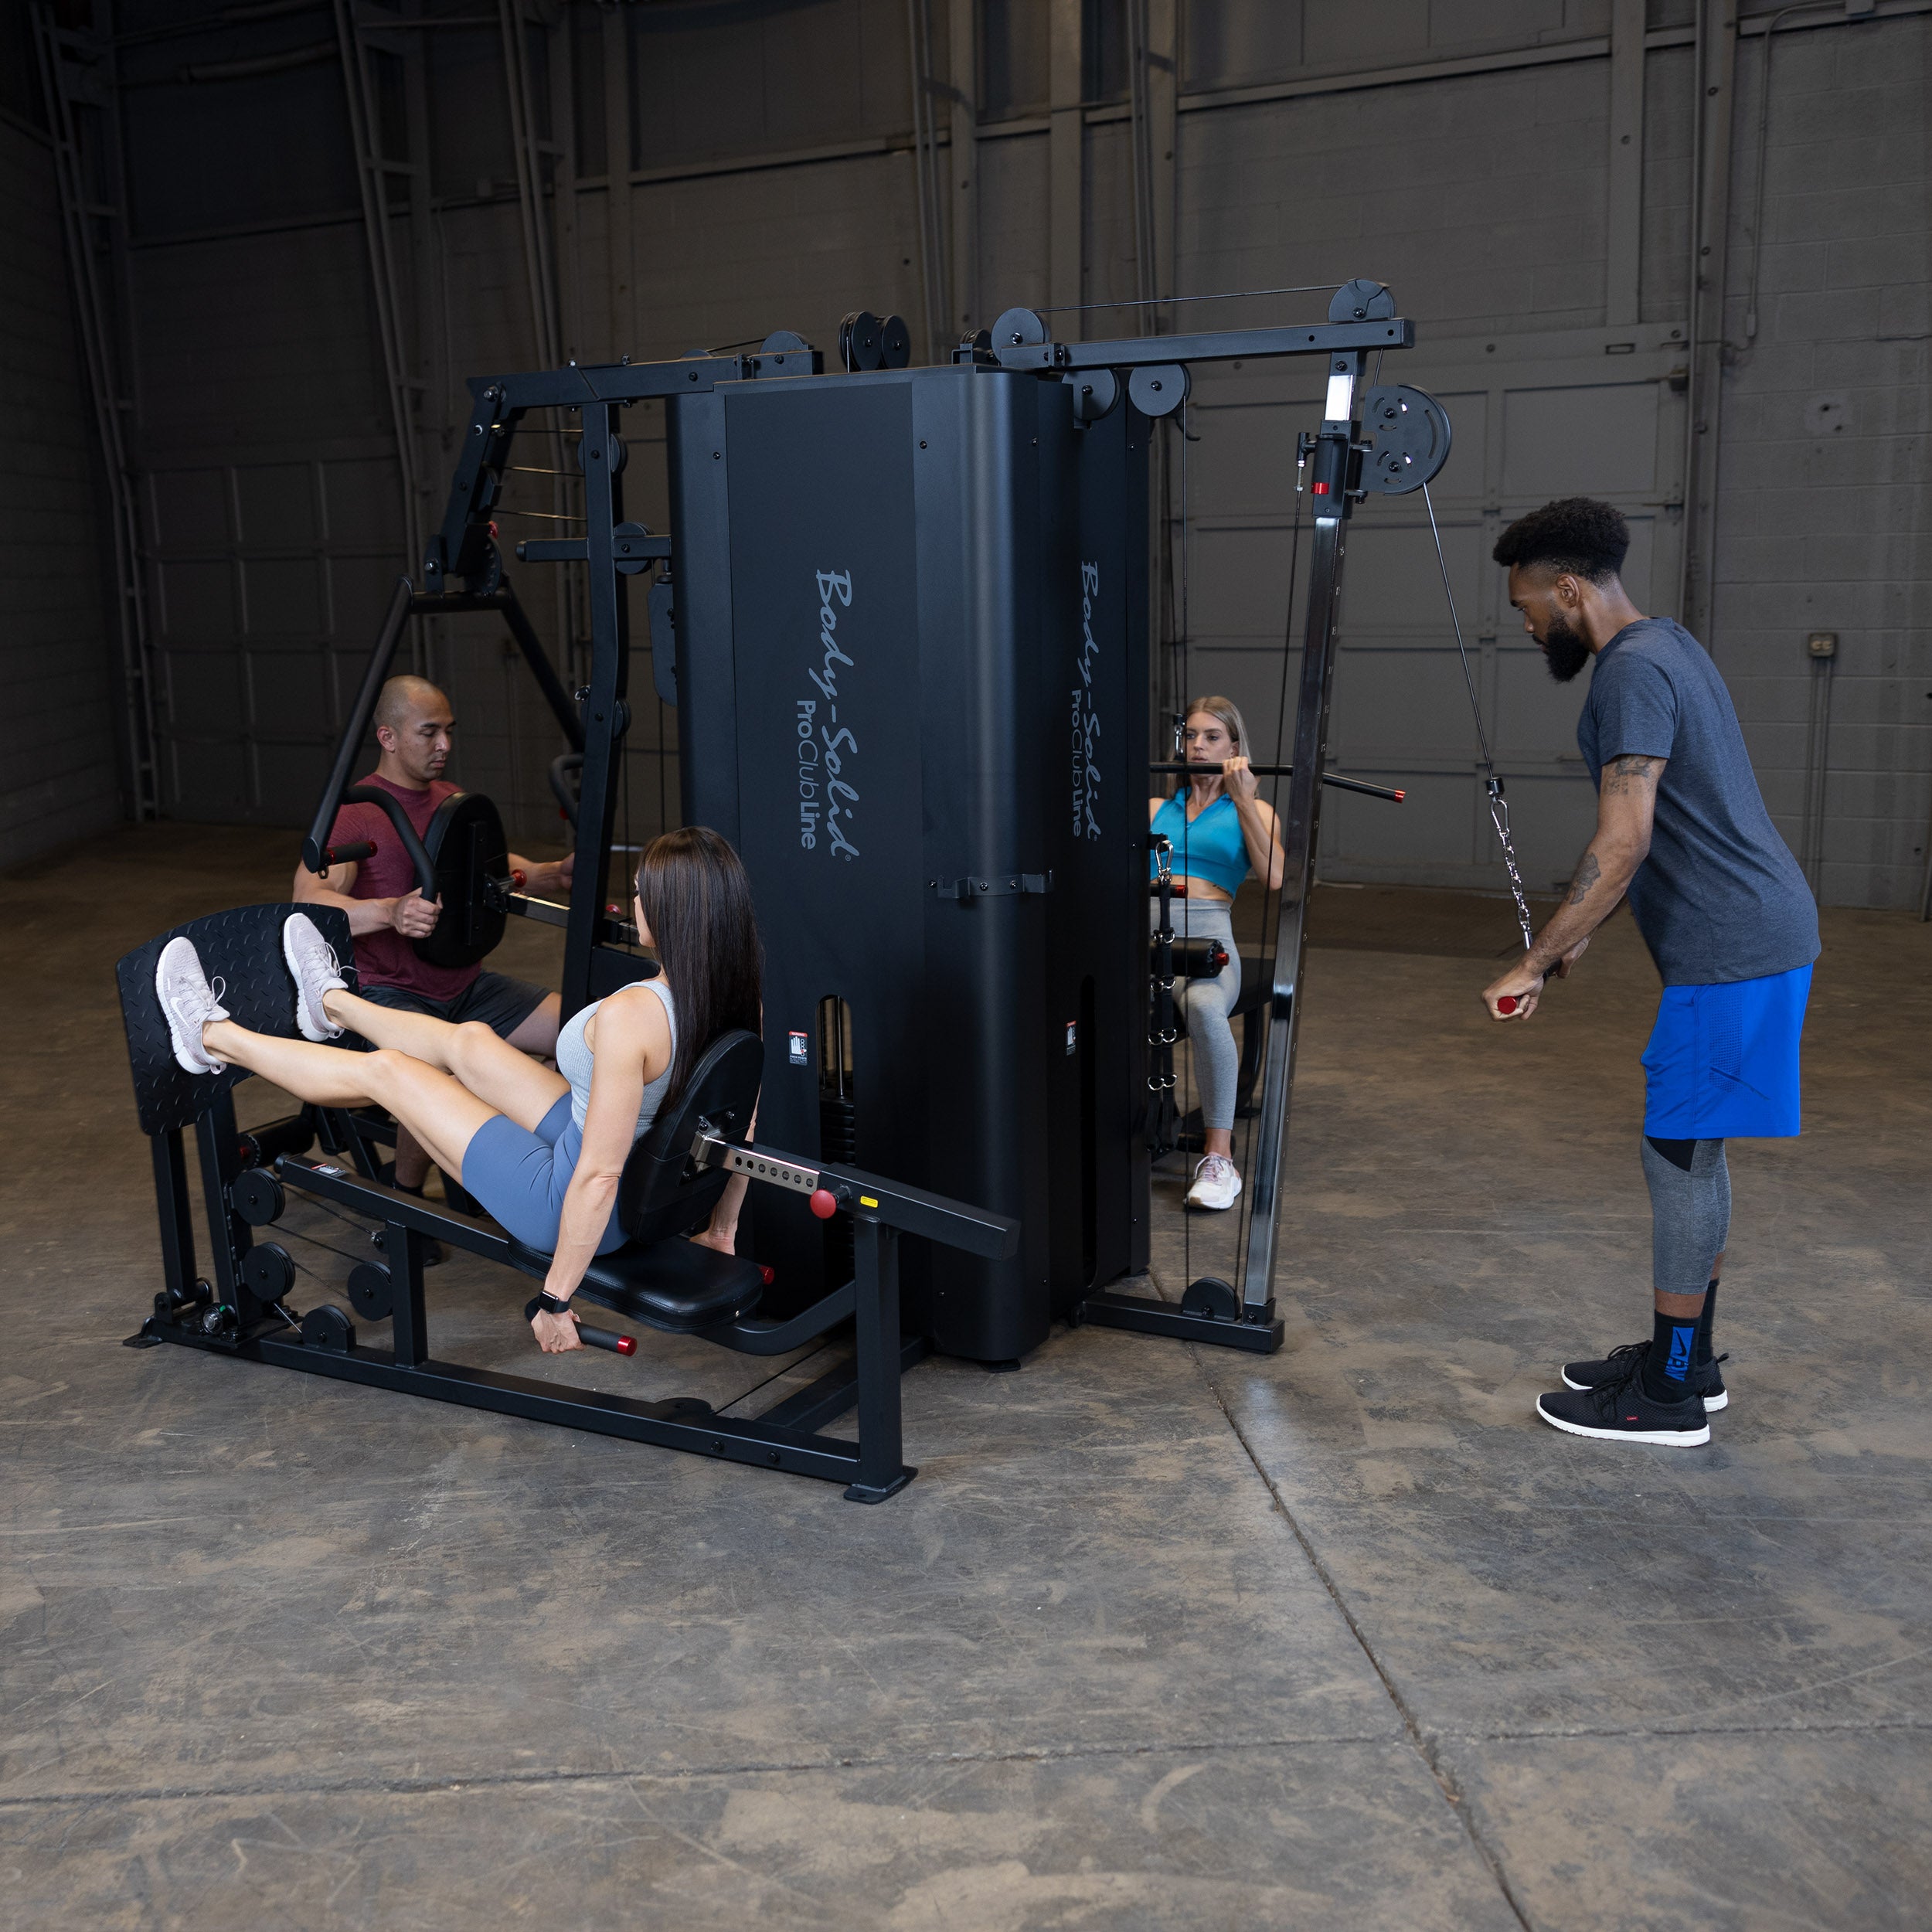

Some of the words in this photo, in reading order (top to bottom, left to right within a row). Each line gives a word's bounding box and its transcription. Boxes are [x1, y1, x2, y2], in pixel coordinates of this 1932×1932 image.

[796, 700, 820, 850] ProClubLine
[809, 570, 860, 857] Body-Solid
[1071, 689, 1083, 837] ProClubLine
[1078, 560, 1100, 839] Body-Solid
